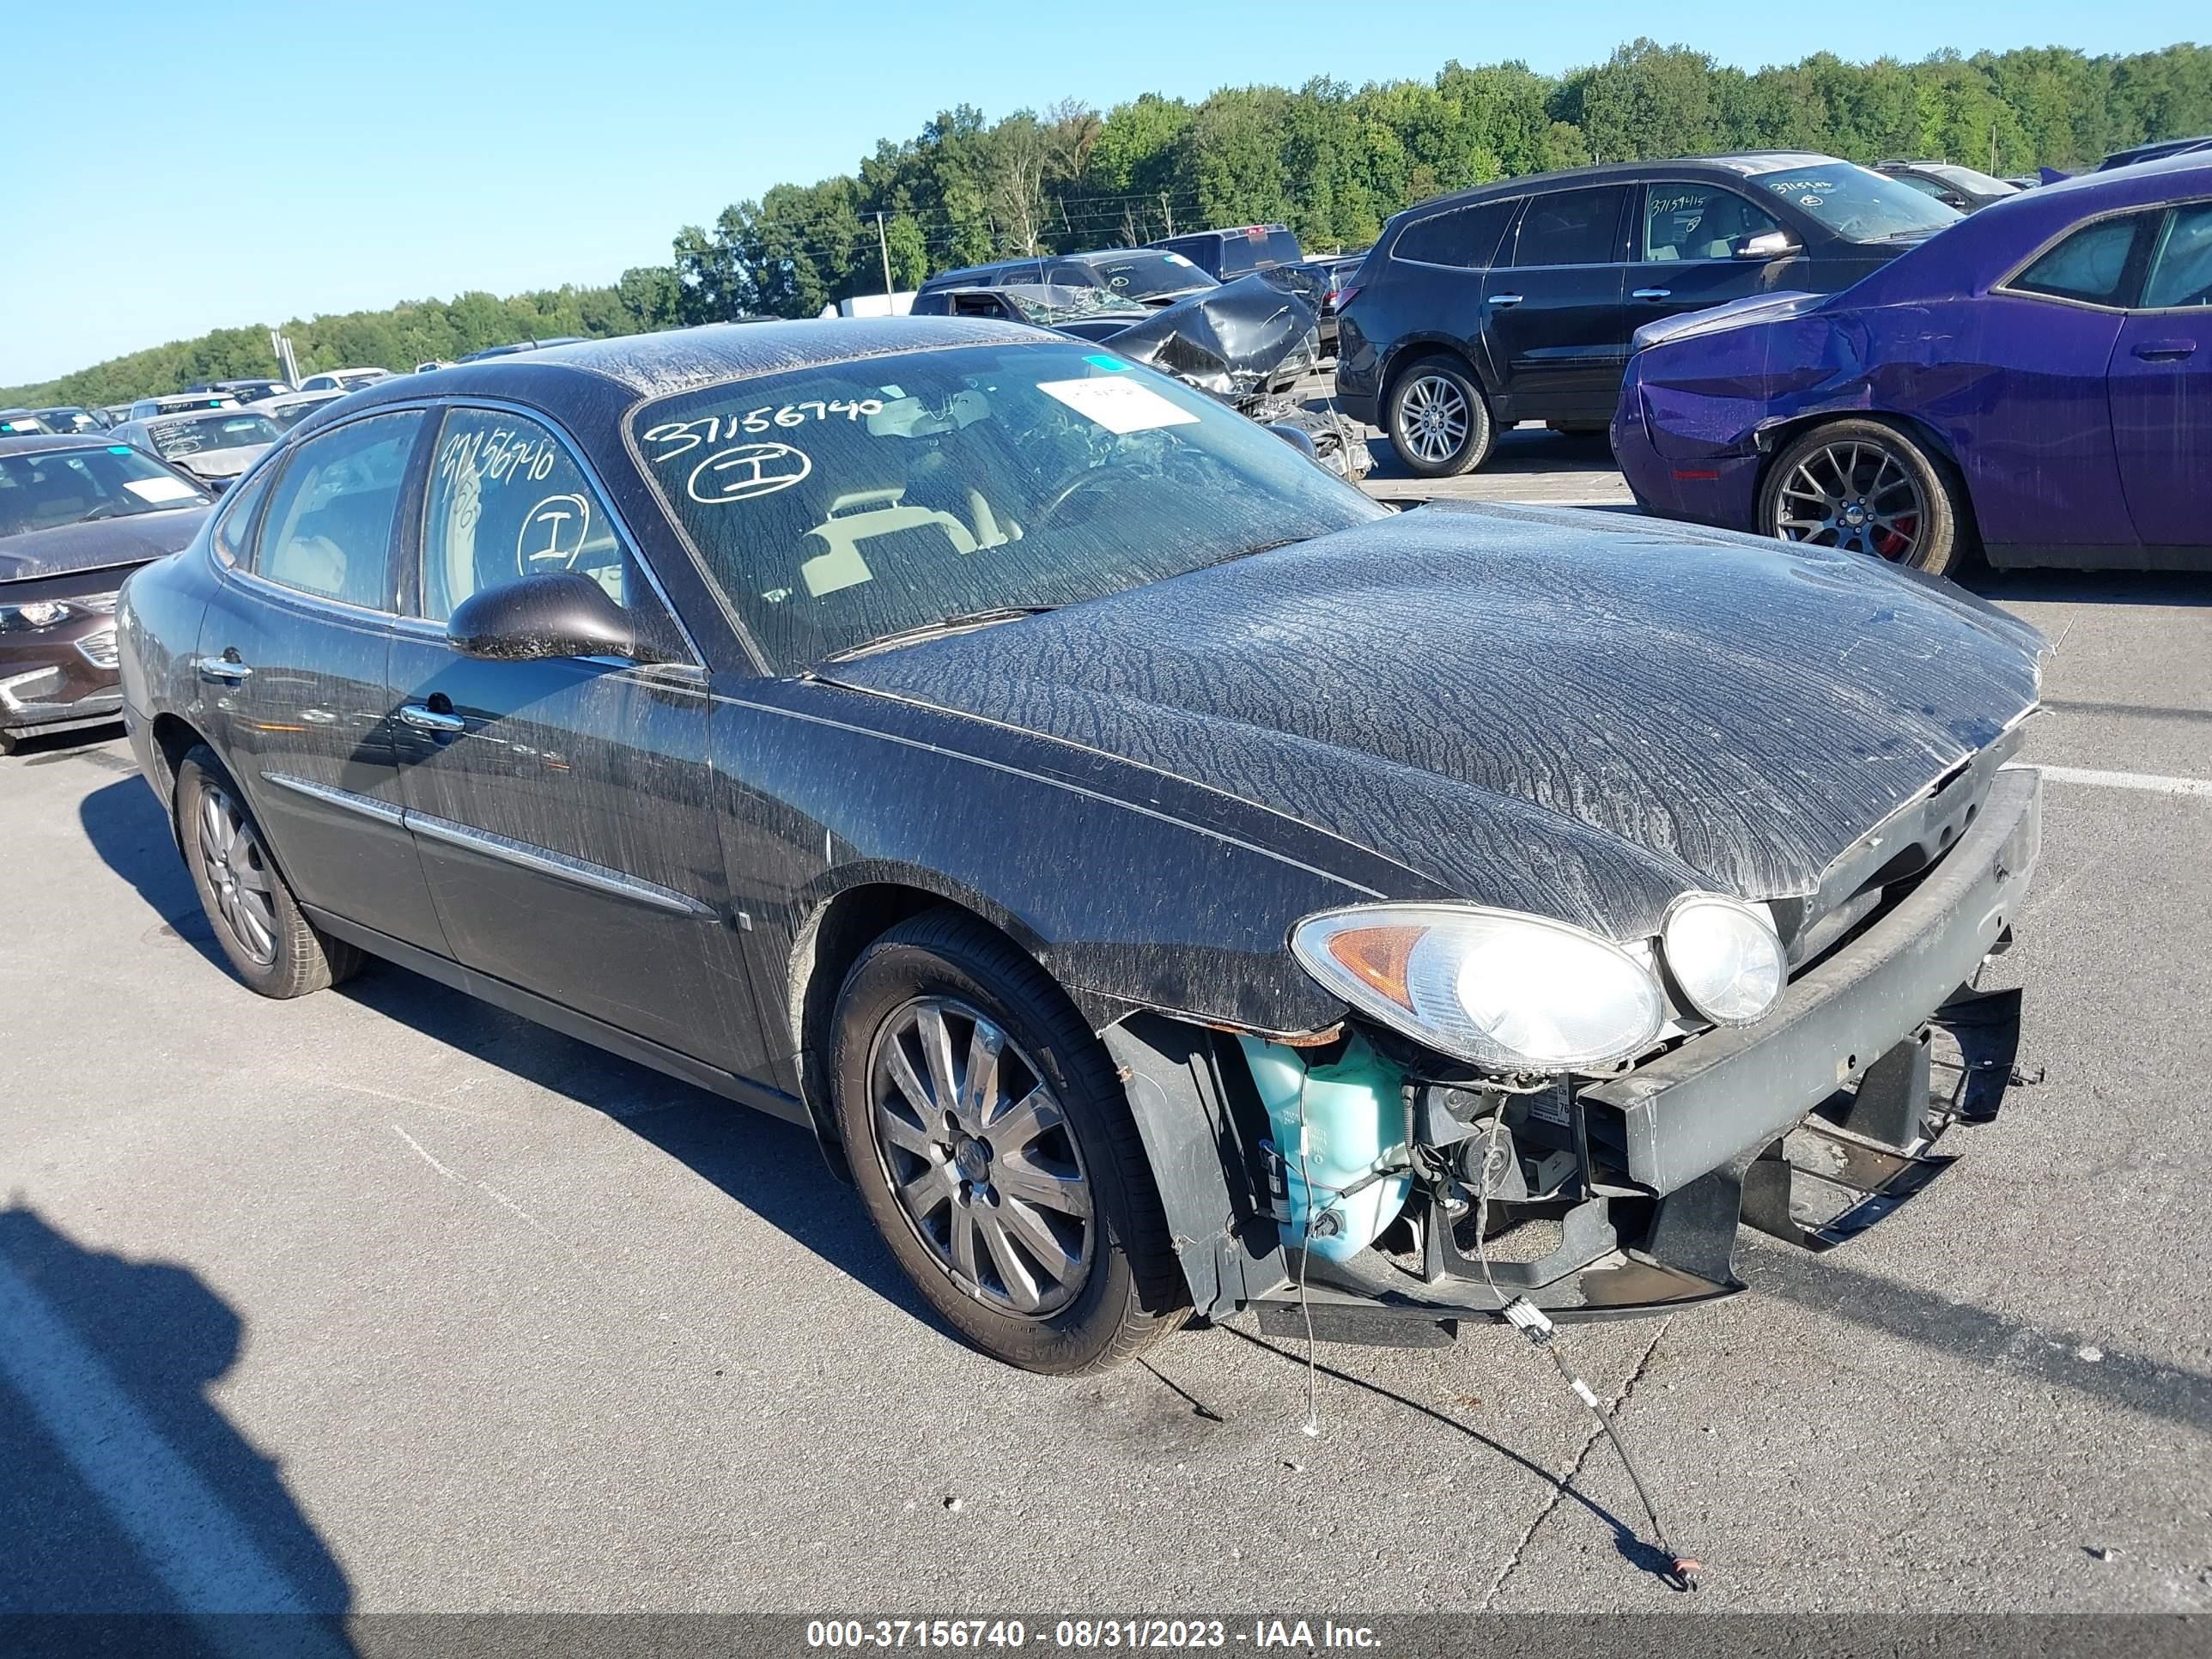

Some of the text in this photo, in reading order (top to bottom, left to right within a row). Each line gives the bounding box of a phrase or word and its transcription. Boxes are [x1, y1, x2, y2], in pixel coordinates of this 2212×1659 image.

[1650, 194, 1708, 217] 37159415
[643, 399, 884, 463] 37156740
[440, 426, 556, 503] 37156740
